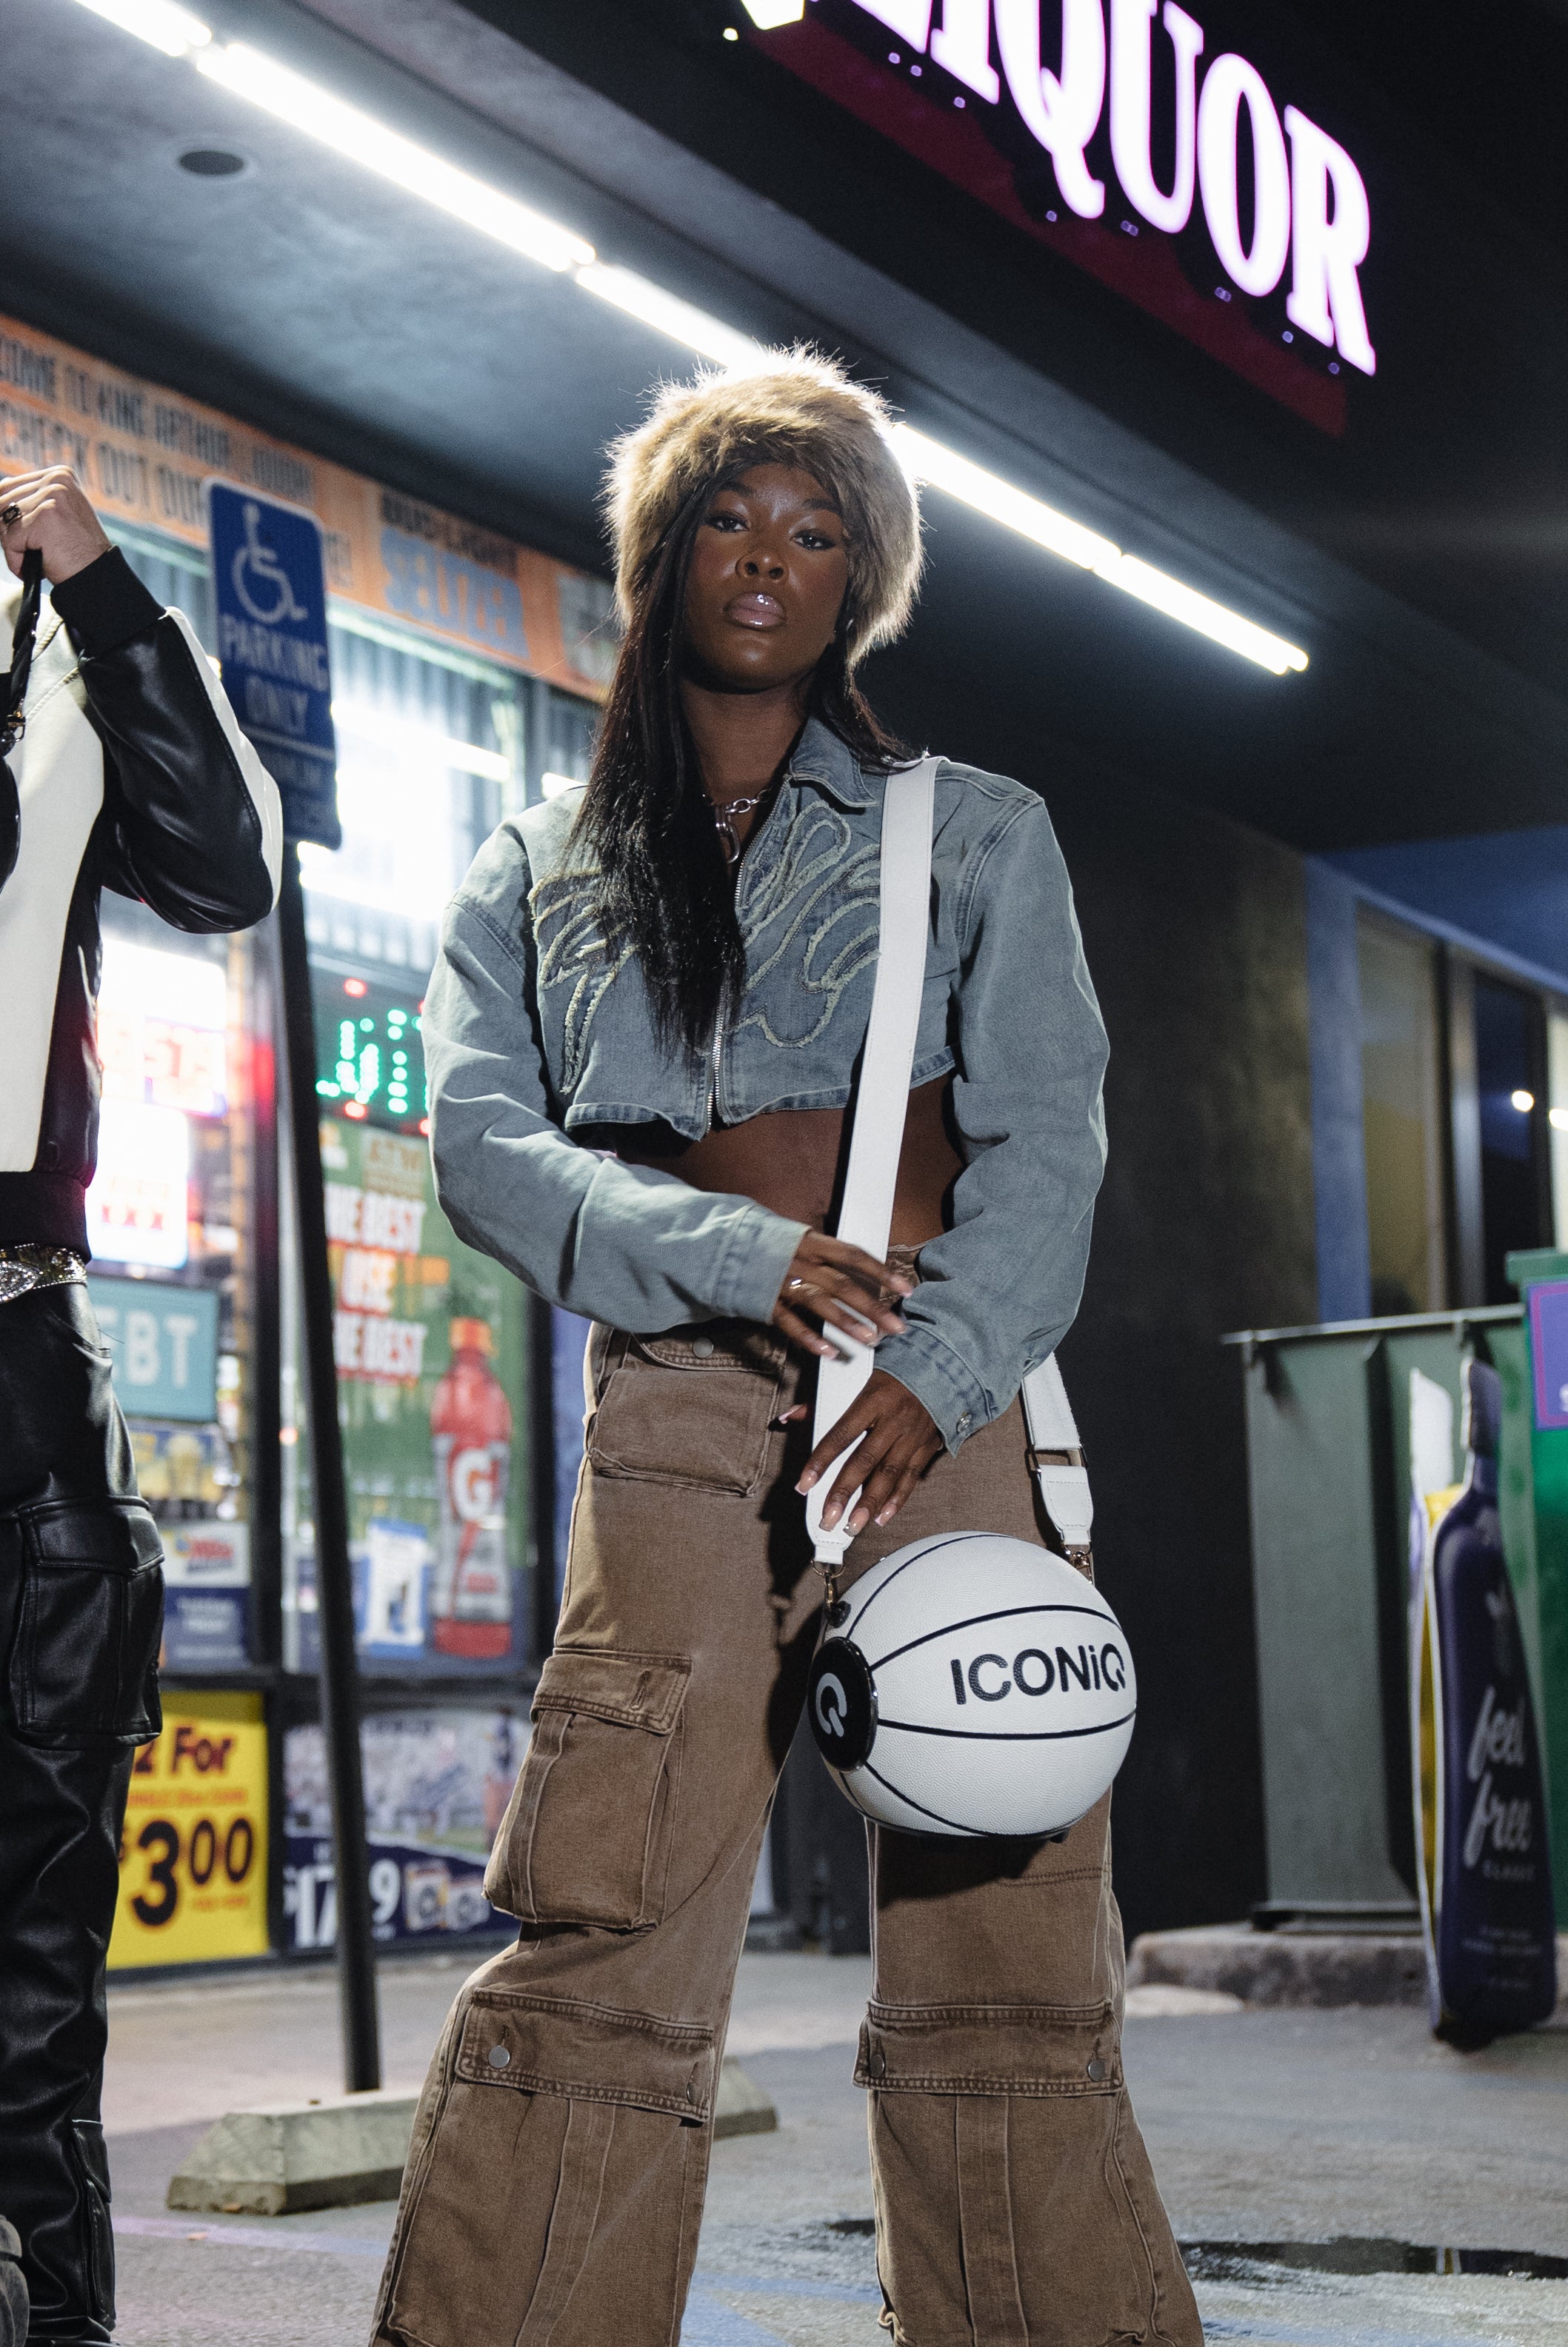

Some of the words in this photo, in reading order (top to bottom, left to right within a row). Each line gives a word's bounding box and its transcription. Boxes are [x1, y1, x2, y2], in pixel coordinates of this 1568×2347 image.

[850, 0, 1376, 376] QUOR
[223, 613, 330, 693] PARKING
[244, 674, 309, 735] ONLY
[170, 1724, 237, 1776] For
